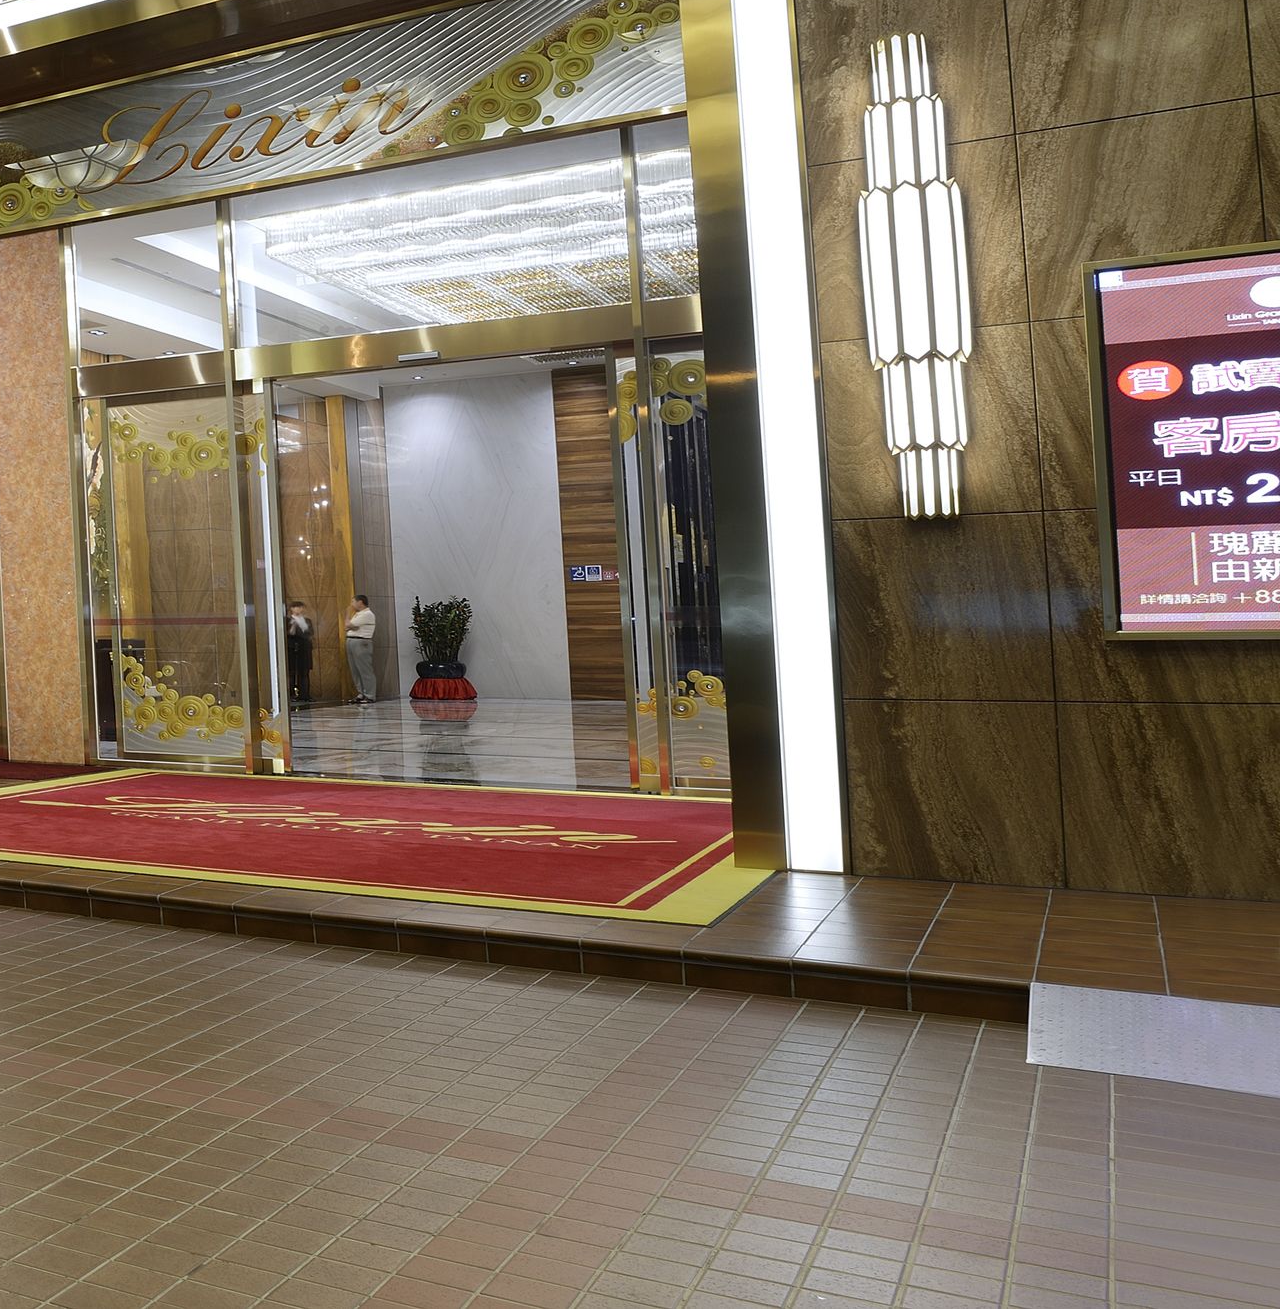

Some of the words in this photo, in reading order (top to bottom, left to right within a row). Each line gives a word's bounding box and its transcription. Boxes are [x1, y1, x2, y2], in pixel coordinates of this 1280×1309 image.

[74, 77, 433, 195] Lixin
[1127, 366, 1170, 395] 賀
[1152, 411, 1280, 458] 客房
[1128, 468, 1182, 487] 平日
[1180, 487, 1234, 507] NT$
[110, 812, 245, 825] GRAND
[255, 822, 403, 836] HOTEL
[424, 833, 607, 850] TAINAN
